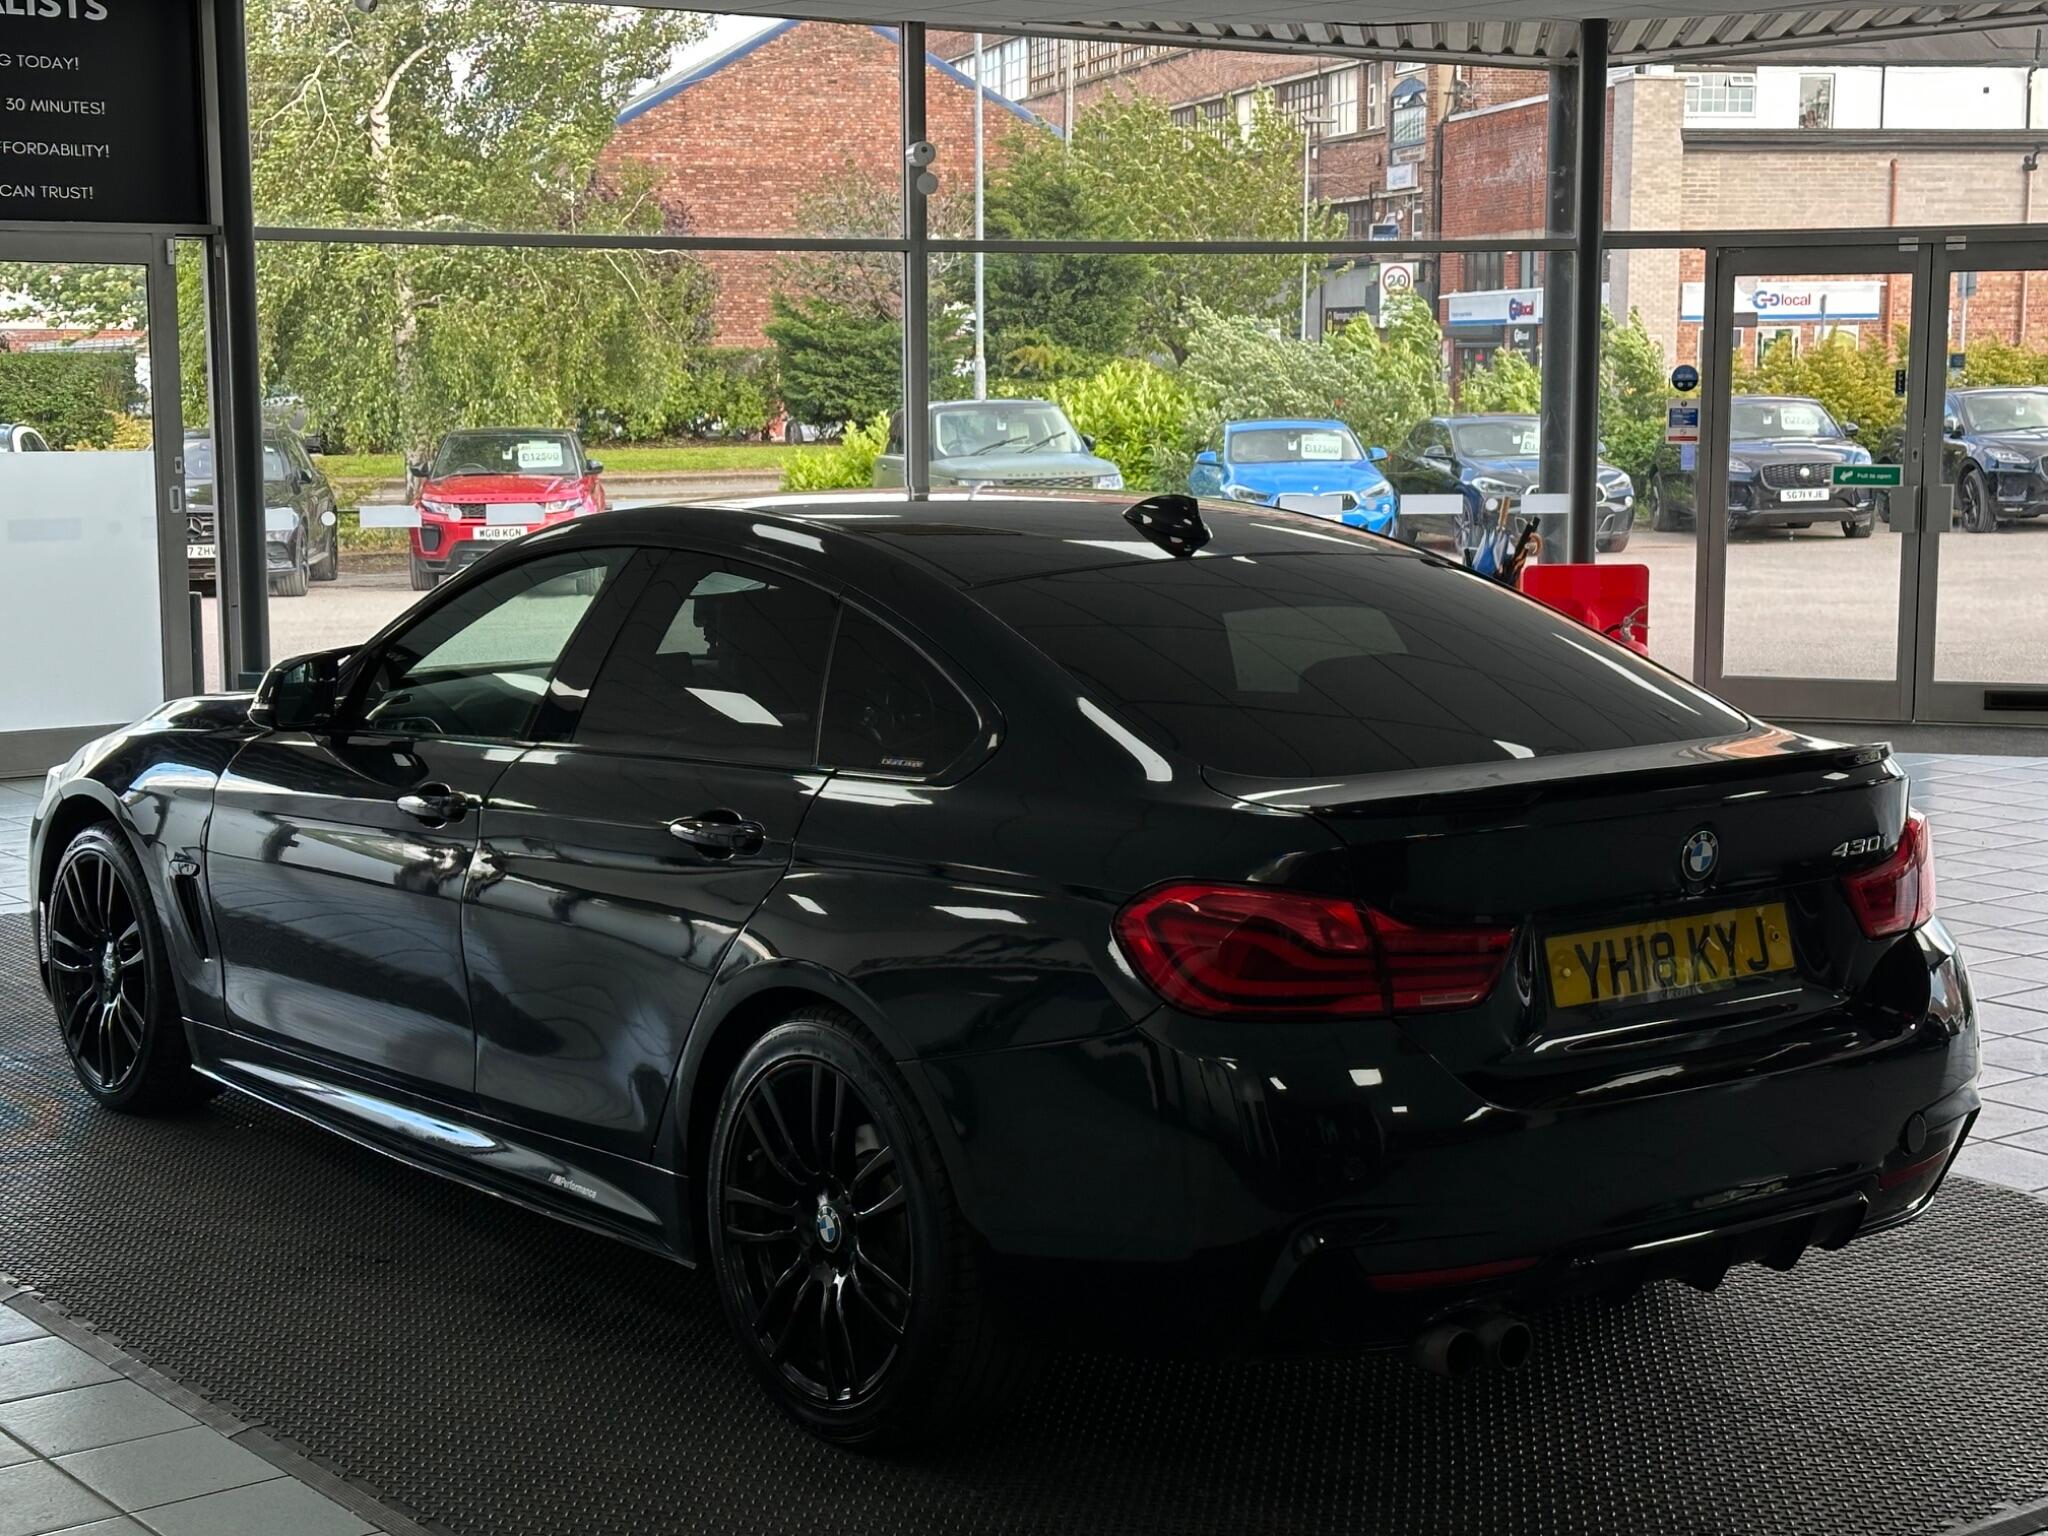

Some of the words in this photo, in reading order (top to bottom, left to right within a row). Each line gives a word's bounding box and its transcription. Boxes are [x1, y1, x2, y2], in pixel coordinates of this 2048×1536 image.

[16, 54, 79, 71] TODAY!
[5, 98, 25, 111] 30
[30, 100, 105, 115] MINUTES!
[0, 185, 35, 198] CAN
[40, 185, 93, 200] TRUST!
[1387, 274, 1407, 288] 20
[1574, 931, 1677, 1000] YH18
[1686, 916, 1770, 977] KYJ
